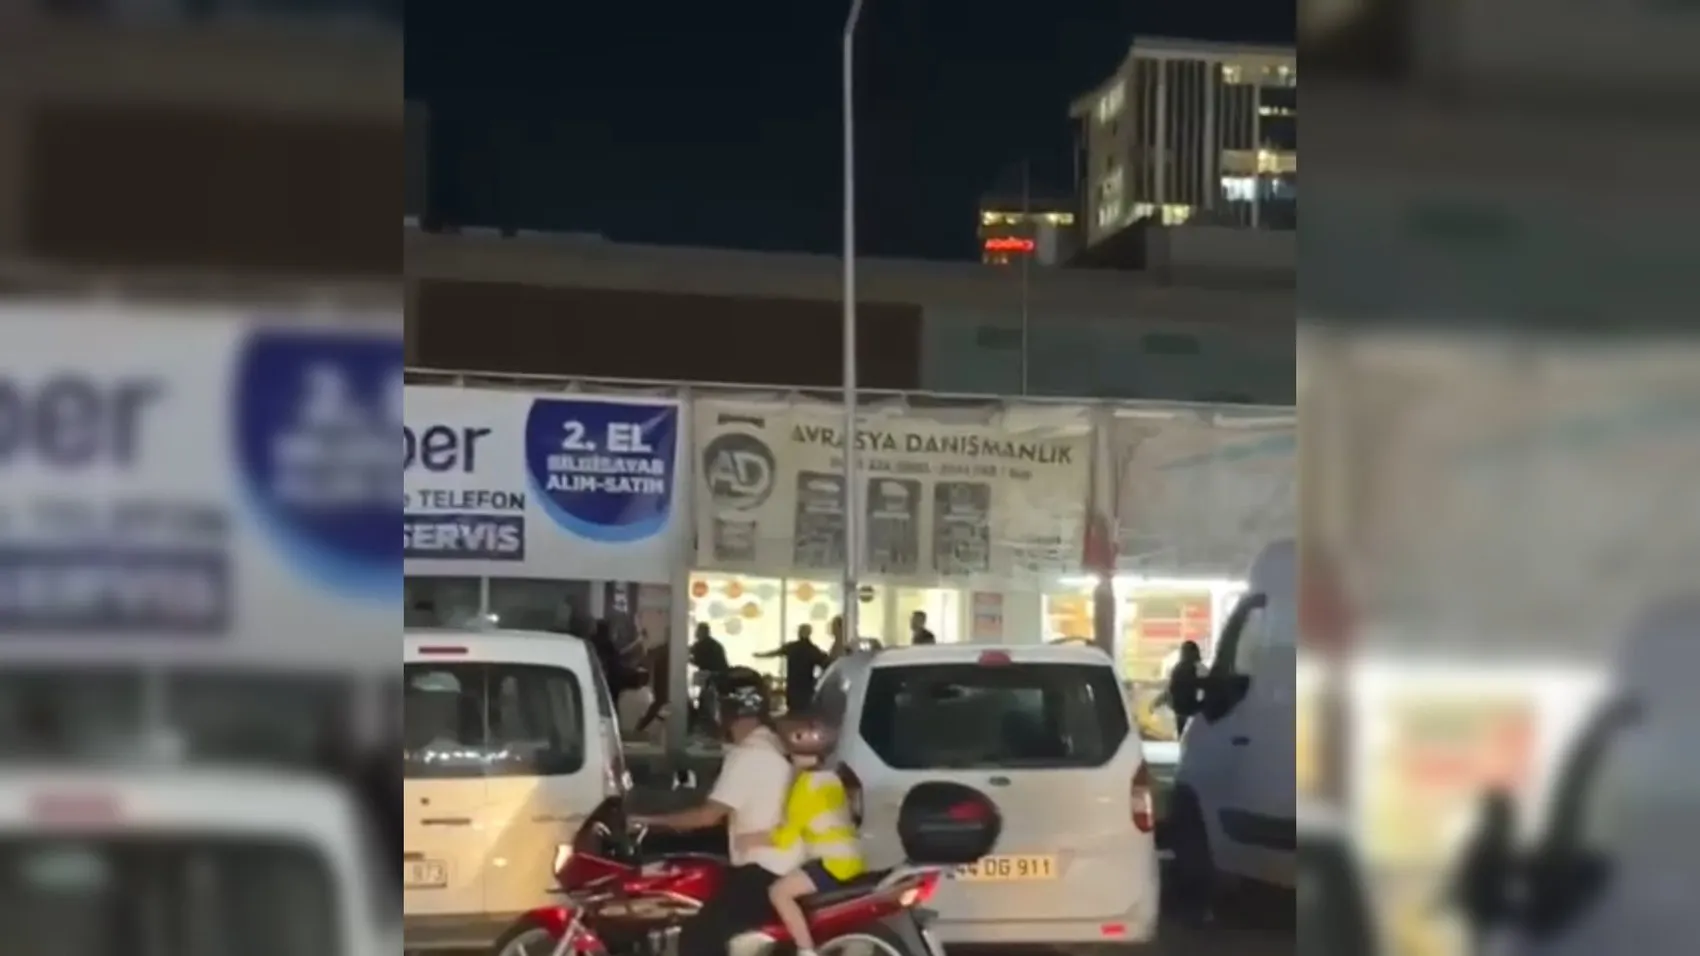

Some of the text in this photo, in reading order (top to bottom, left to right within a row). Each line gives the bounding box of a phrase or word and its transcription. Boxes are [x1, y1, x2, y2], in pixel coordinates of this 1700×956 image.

[562, 420, 652, 452] 2. EL
[791, 424, 897, 451] AVRSYA
[418, 489, 525, 511] TELEFON
[1016, 858, 1050, 876] 911
